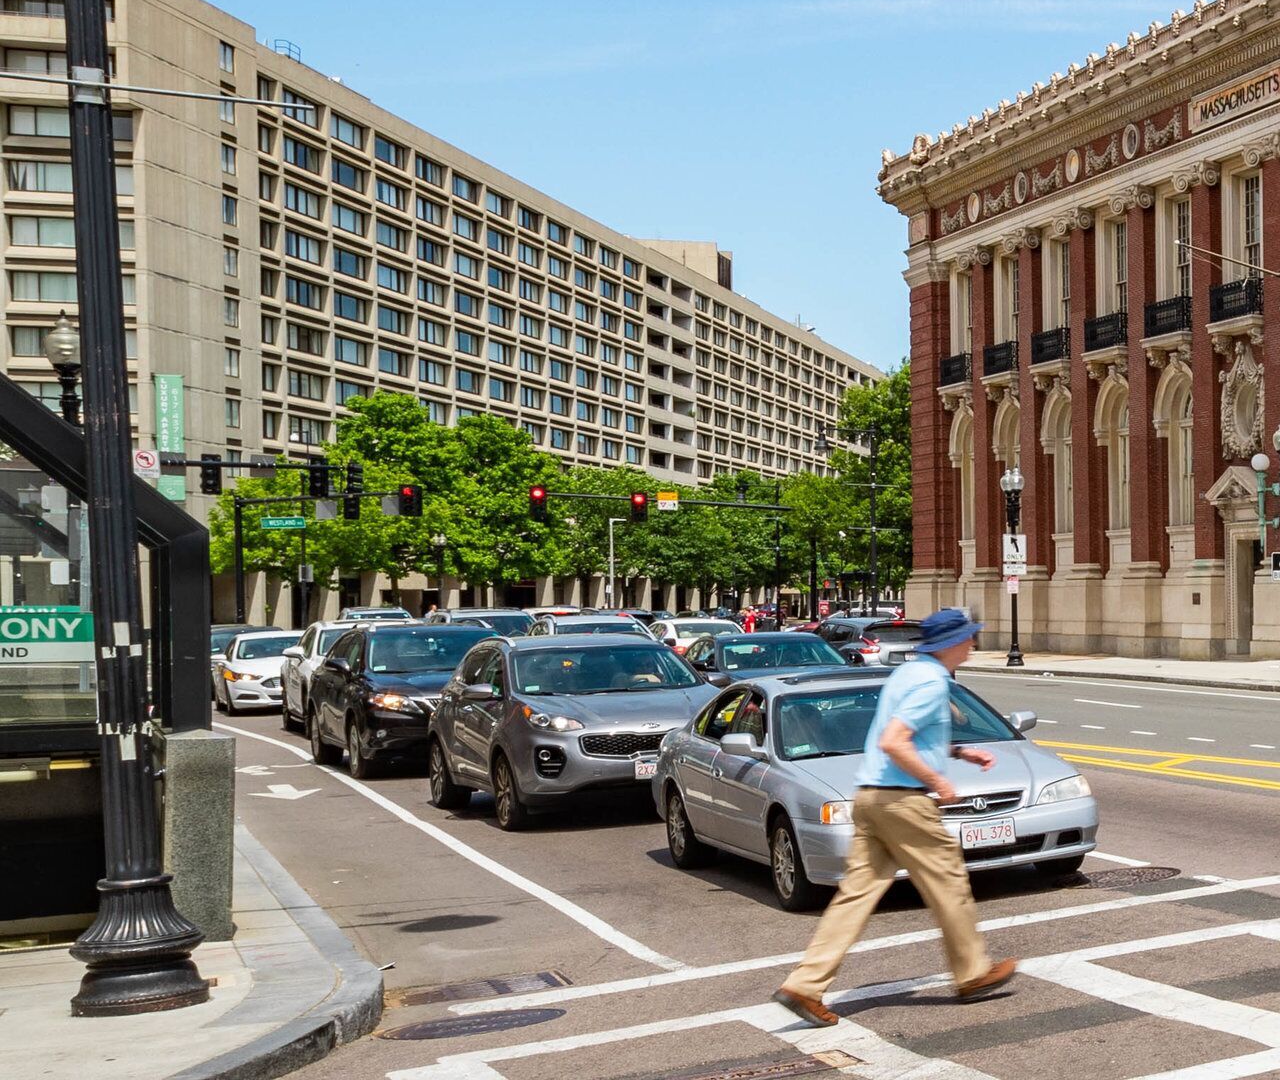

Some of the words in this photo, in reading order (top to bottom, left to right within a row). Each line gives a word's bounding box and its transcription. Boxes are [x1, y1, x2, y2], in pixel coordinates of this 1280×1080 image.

[1200, 73, 1280, 122] MASSACHUSETTS
[160, 378, 168, 414] LUXURY
[161, 417, 169, 452] APARTM
[965, 828, 988, 843] 6VL
[990, 824, 1012, 839] 378
